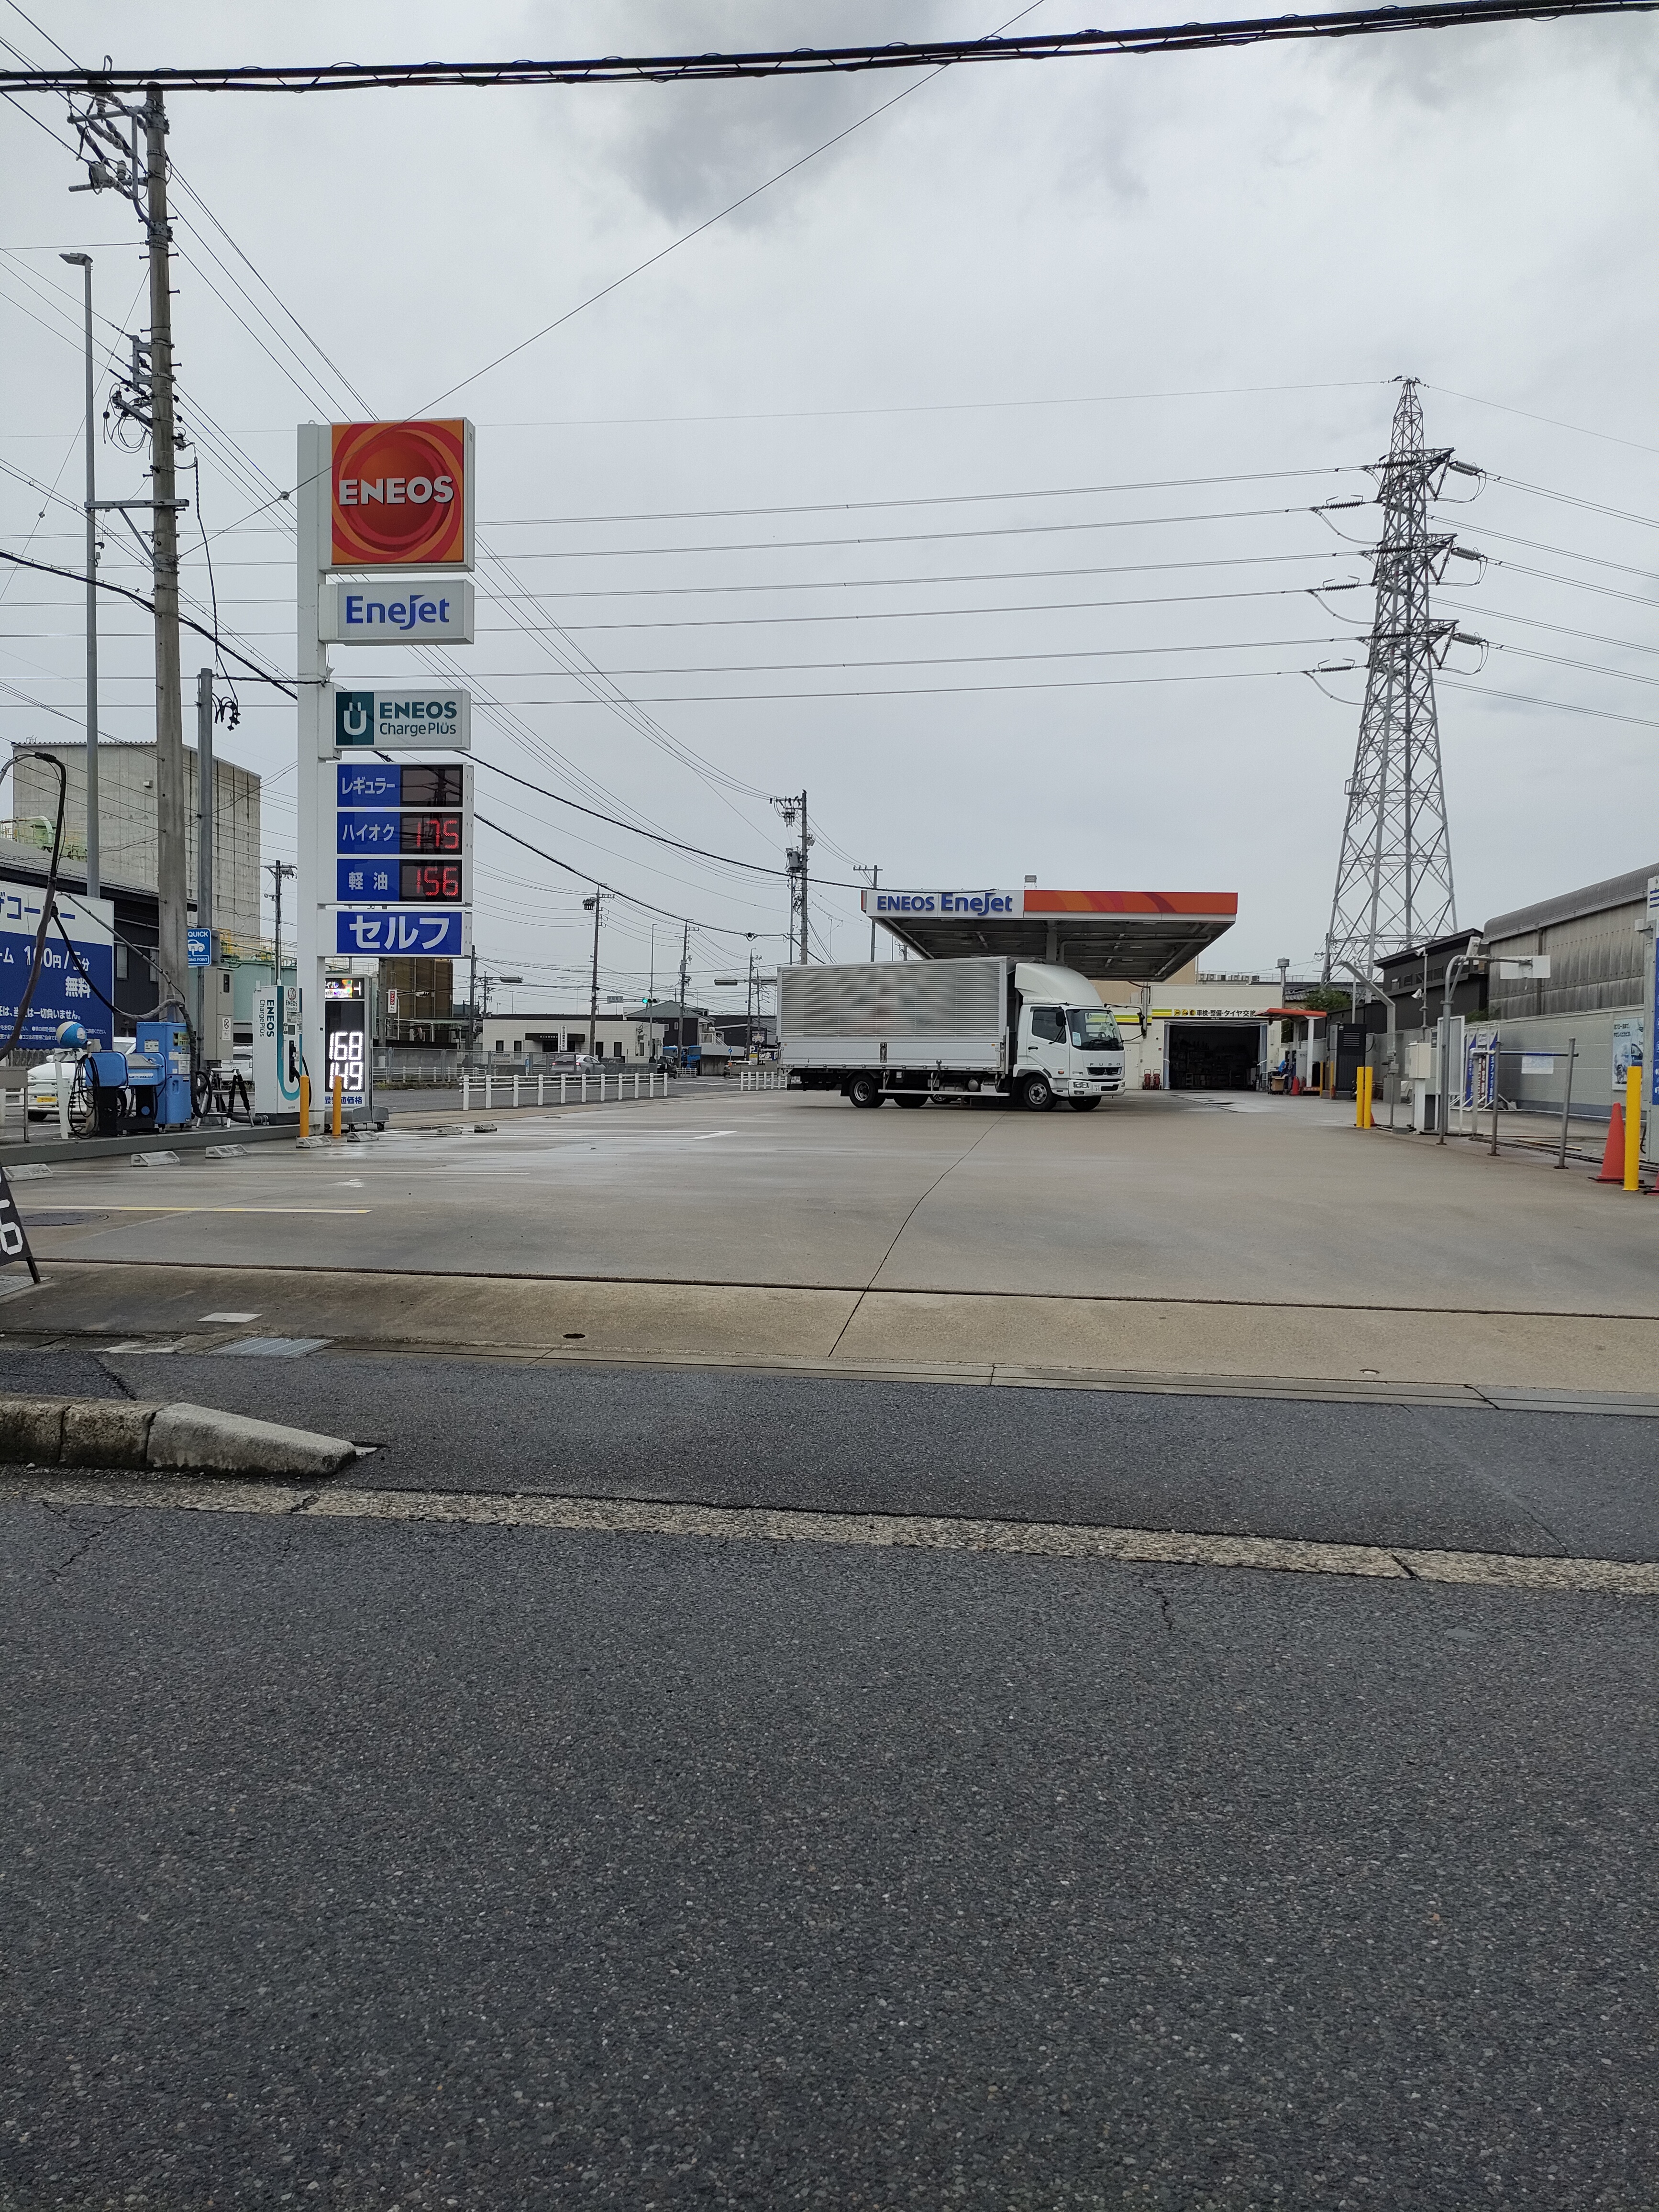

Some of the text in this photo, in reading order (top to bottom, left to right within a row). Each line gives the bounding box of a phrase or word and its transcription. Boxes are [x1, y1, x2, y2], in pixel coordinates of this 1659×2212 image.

[339, 476, 453, 505] ENEOS
[379, 701, 457, 719] ENEOS
[342, 777, 396, 795] レギュラー
[342, 824, 395, 841] ハイオク
[416, 820, 459, 849] 175
[348, 872, 388, 890] 軽油
[416, 868, 459, 896] 156
[877, 896, 935, 911] ENEOS
[349, 915, 450, 950] セルフ
[65, 976, 91, 998] 無料
[266, 999, 275, 1037] ENEOS
[329, 1031, 364, 1061] 168
[329, 1062, 364, 1090] 149
